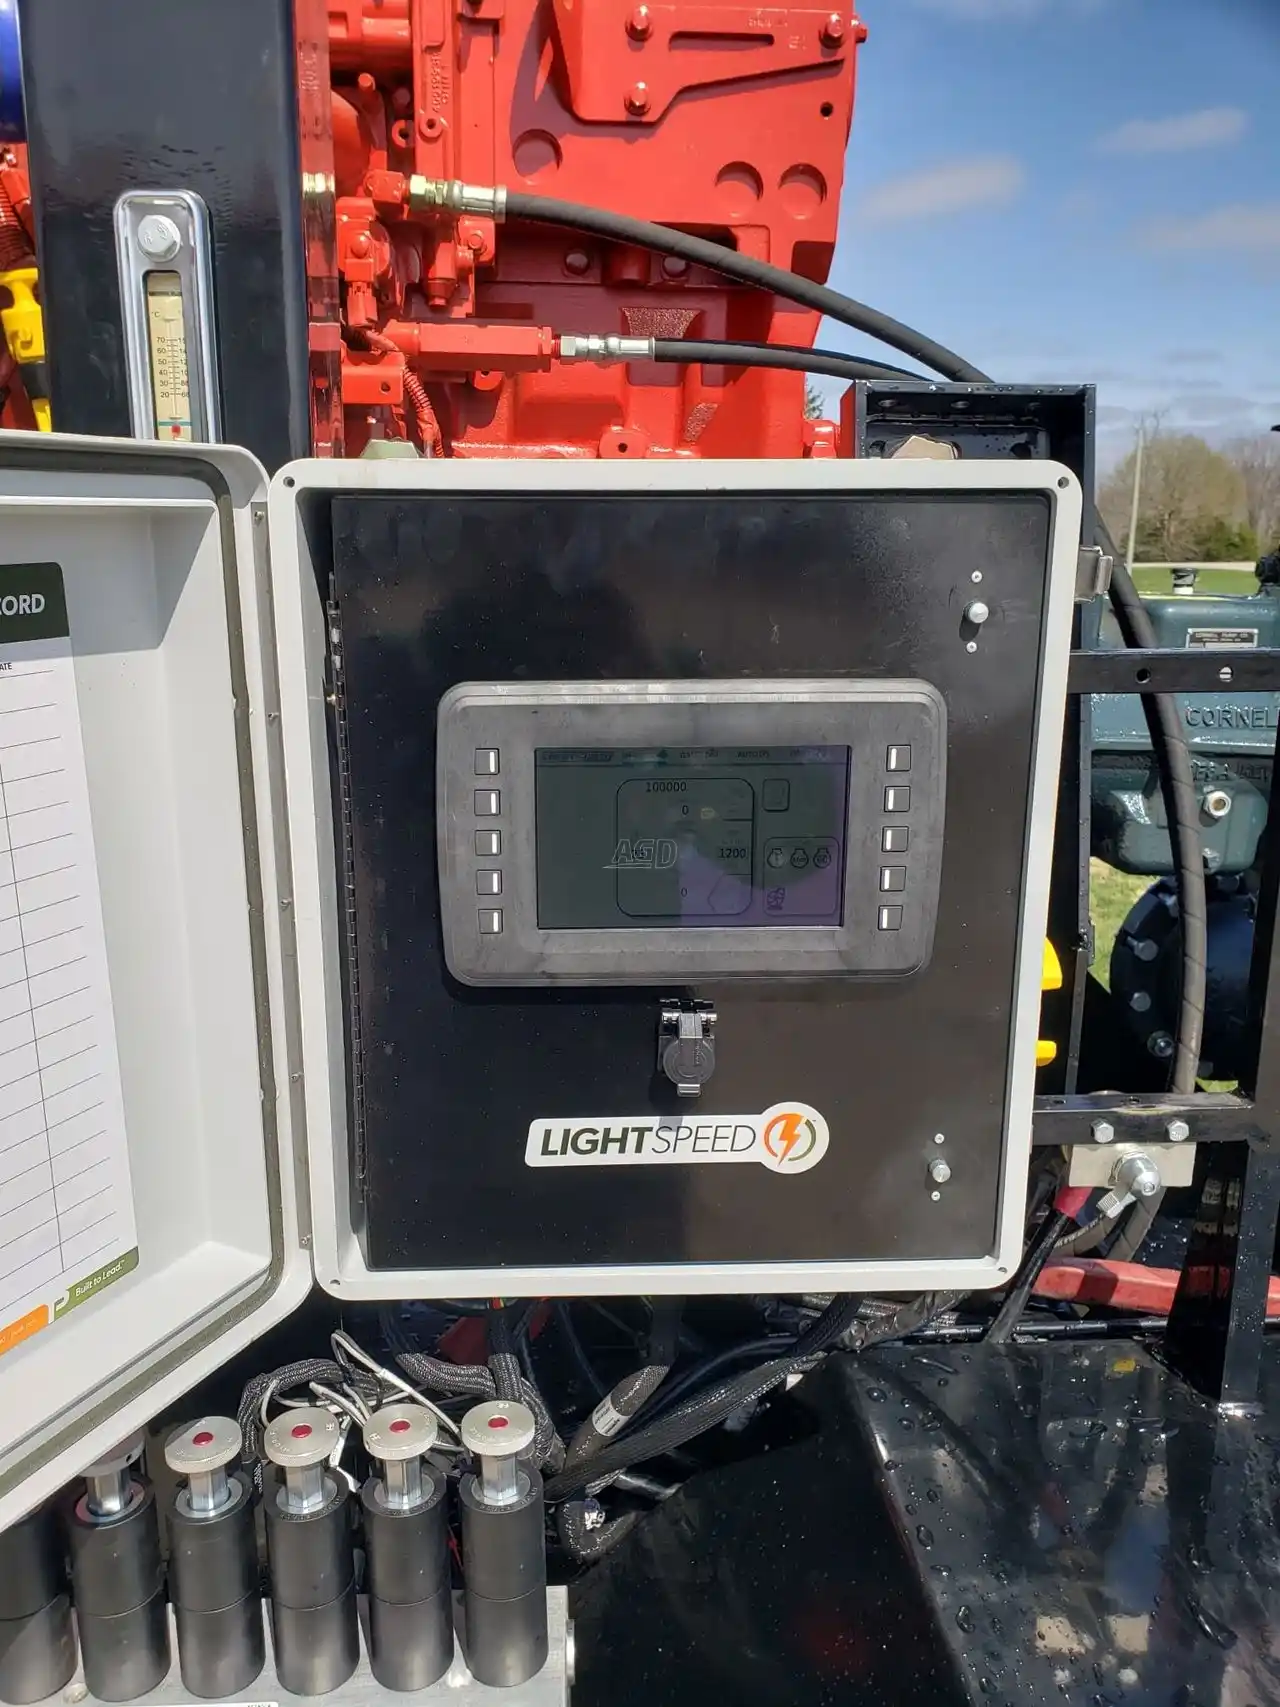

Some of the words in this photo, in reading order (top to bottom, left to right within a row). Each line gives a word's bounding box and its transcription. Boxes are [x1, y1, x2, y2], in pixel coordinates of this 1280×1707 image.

[0, 594, 46, 616] ORD
[1186, 705, 1280, 728] CORNEL
[645, 781, 687, 792] 100000
[681, 805, 689, 816] 0
[719, 848, 746, 859] 1200
[680, 887, 688, 898] 0
[541, 1125, 756, 1156] LIGHTSPEED
[75, 1280, 93, 1297] Built
[93, 1276, 102, 1286] to
